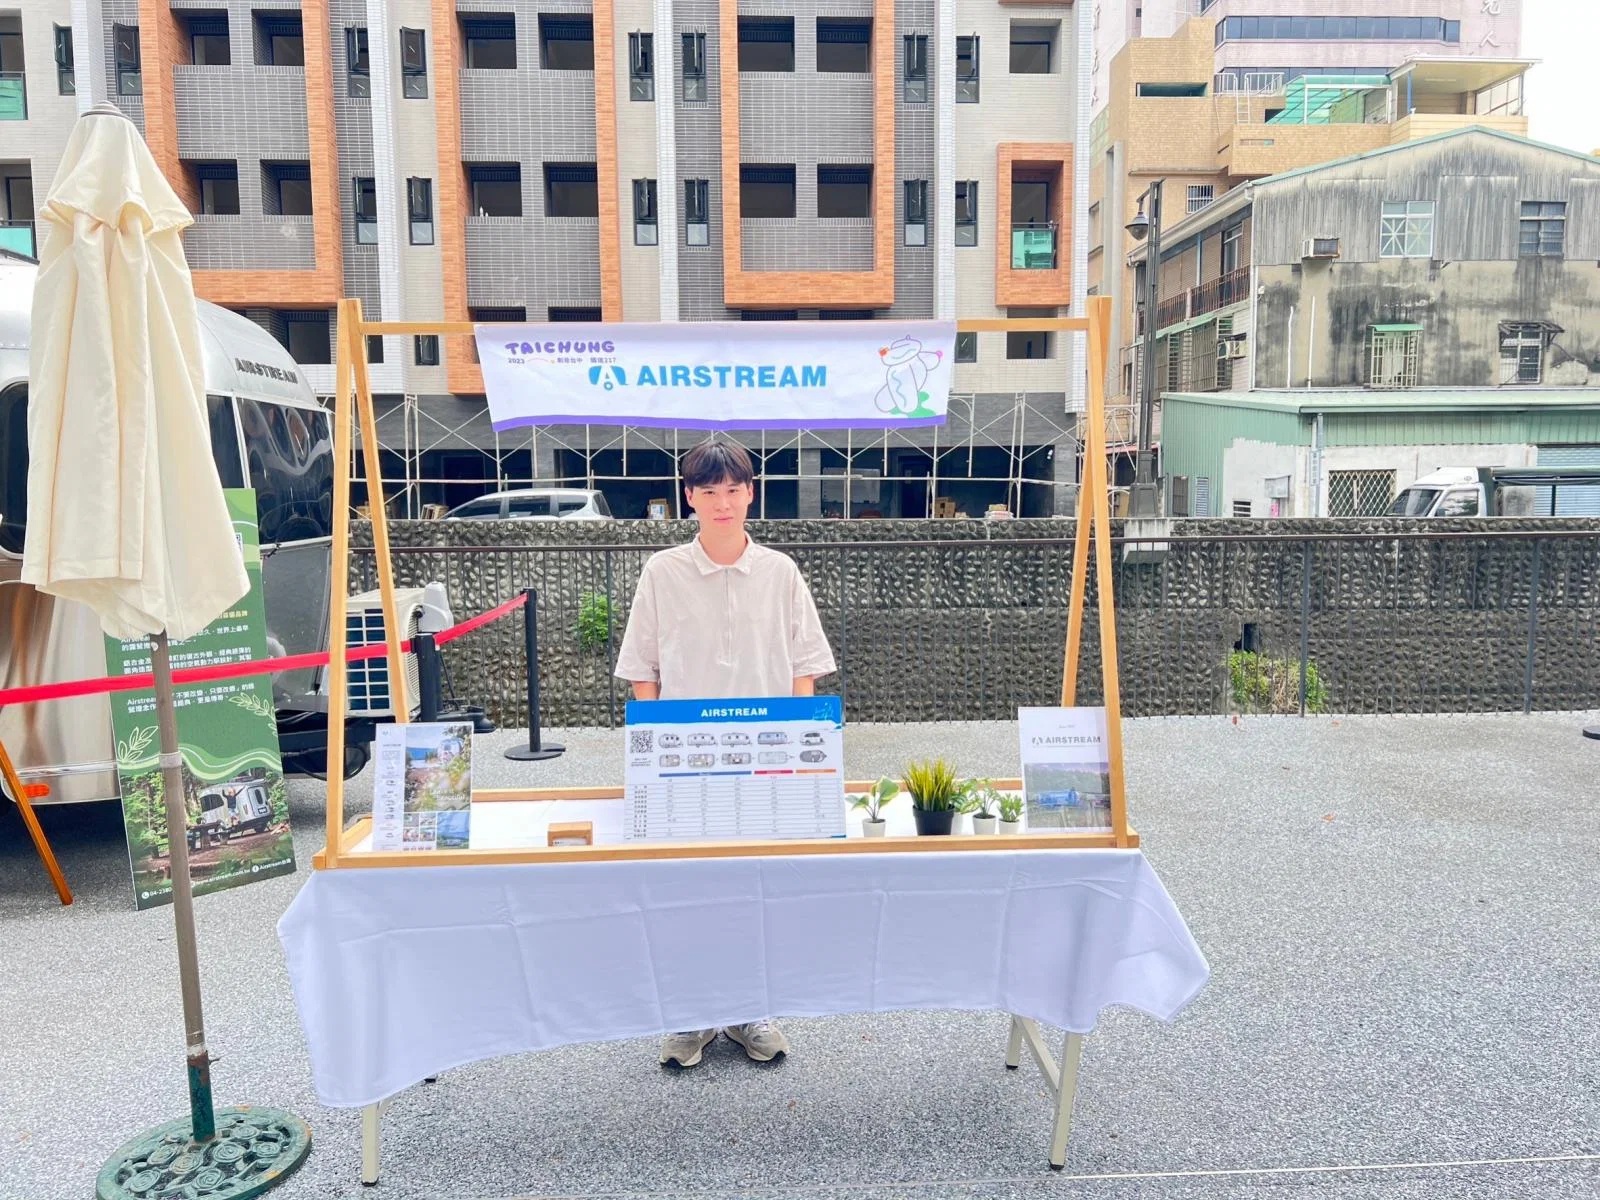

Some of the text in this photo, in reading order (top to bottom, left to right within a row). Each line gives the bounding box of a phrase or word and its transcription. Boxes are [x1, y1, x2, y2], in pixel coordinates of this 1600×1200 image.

[505, 341, 615, 355] TAICHUNG
[235, 358, 298, 384] AIRSTREAM
[637, 365, 827, 388] AIRSTREAM
[701, 707, 768, 717] AIRSTREAM
[1045, 736, 1101, 745] AIRSTREAM
